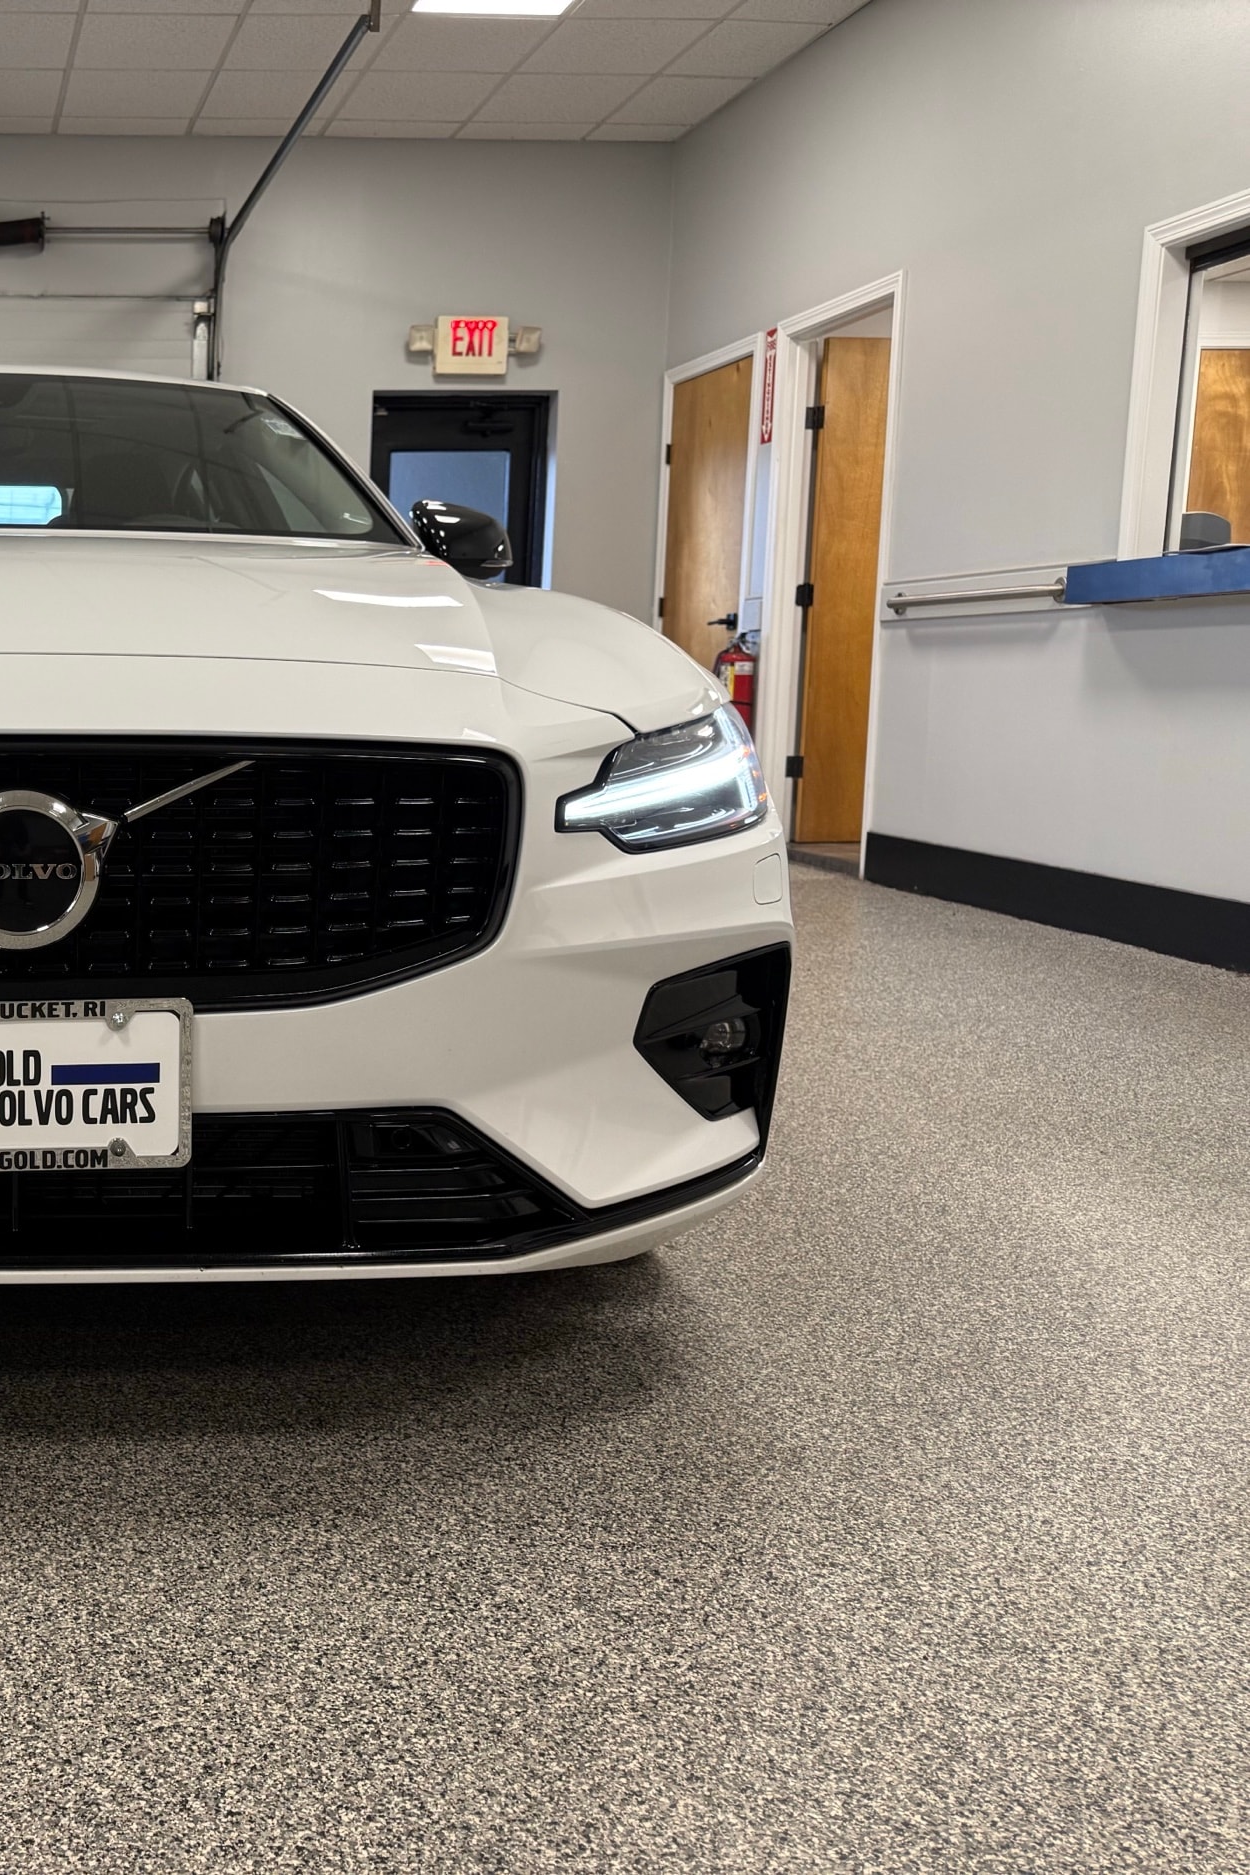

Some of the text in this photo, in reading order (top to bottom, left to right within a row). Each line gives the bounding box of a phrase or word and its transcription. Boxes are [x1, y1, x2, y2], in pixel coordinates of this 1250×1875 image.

[451, 320, 497, 357] EXIT
[84, 1001, 106, 1017] RI
[81, 1087, 157, 1125] CARS
